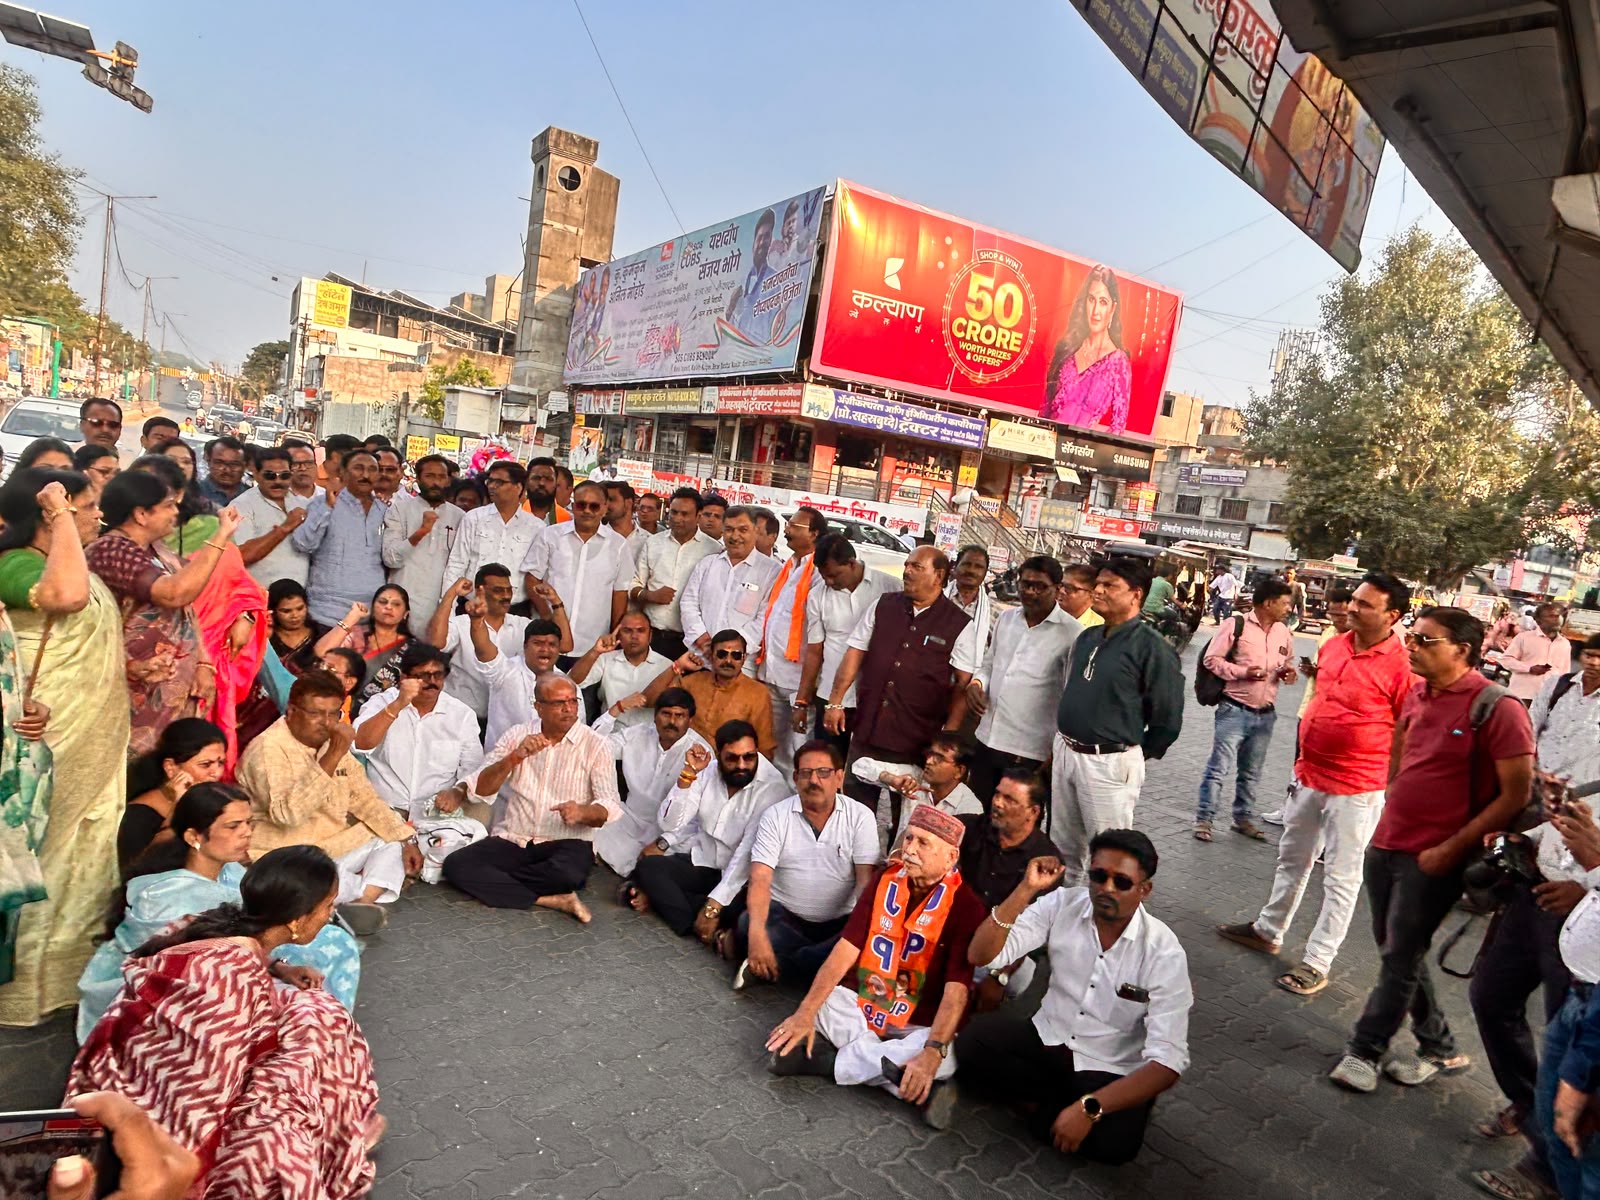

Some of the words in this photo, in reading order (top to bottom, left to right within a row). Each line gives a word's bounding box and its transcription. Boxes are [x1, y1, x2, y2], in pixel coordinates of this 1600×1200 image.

[709, 223, 740, 251] यशदीप
[979, 250, 998, 263] SHOP
[1004, 255, 1020, 270] WIN
[321, 286, 345, 302] हॉटेल
[964, 270, 1024, 329] 50
[851, 288, 925, 324] कल्याण
[951, 316, 1024, 354] CRORE
[958, 339, 988, 357] WORTH
[986, 346, 1012, 362] PRIZES
[965, 352, 972, 361] &
[884, 402, 905, 418] आणि
[898, 417, 939, 438] ट्रॅक्टर
[1061, 440, 1095, 459] सॅमसंग
[1113, 453, 1150, 470] SAMSUNG
